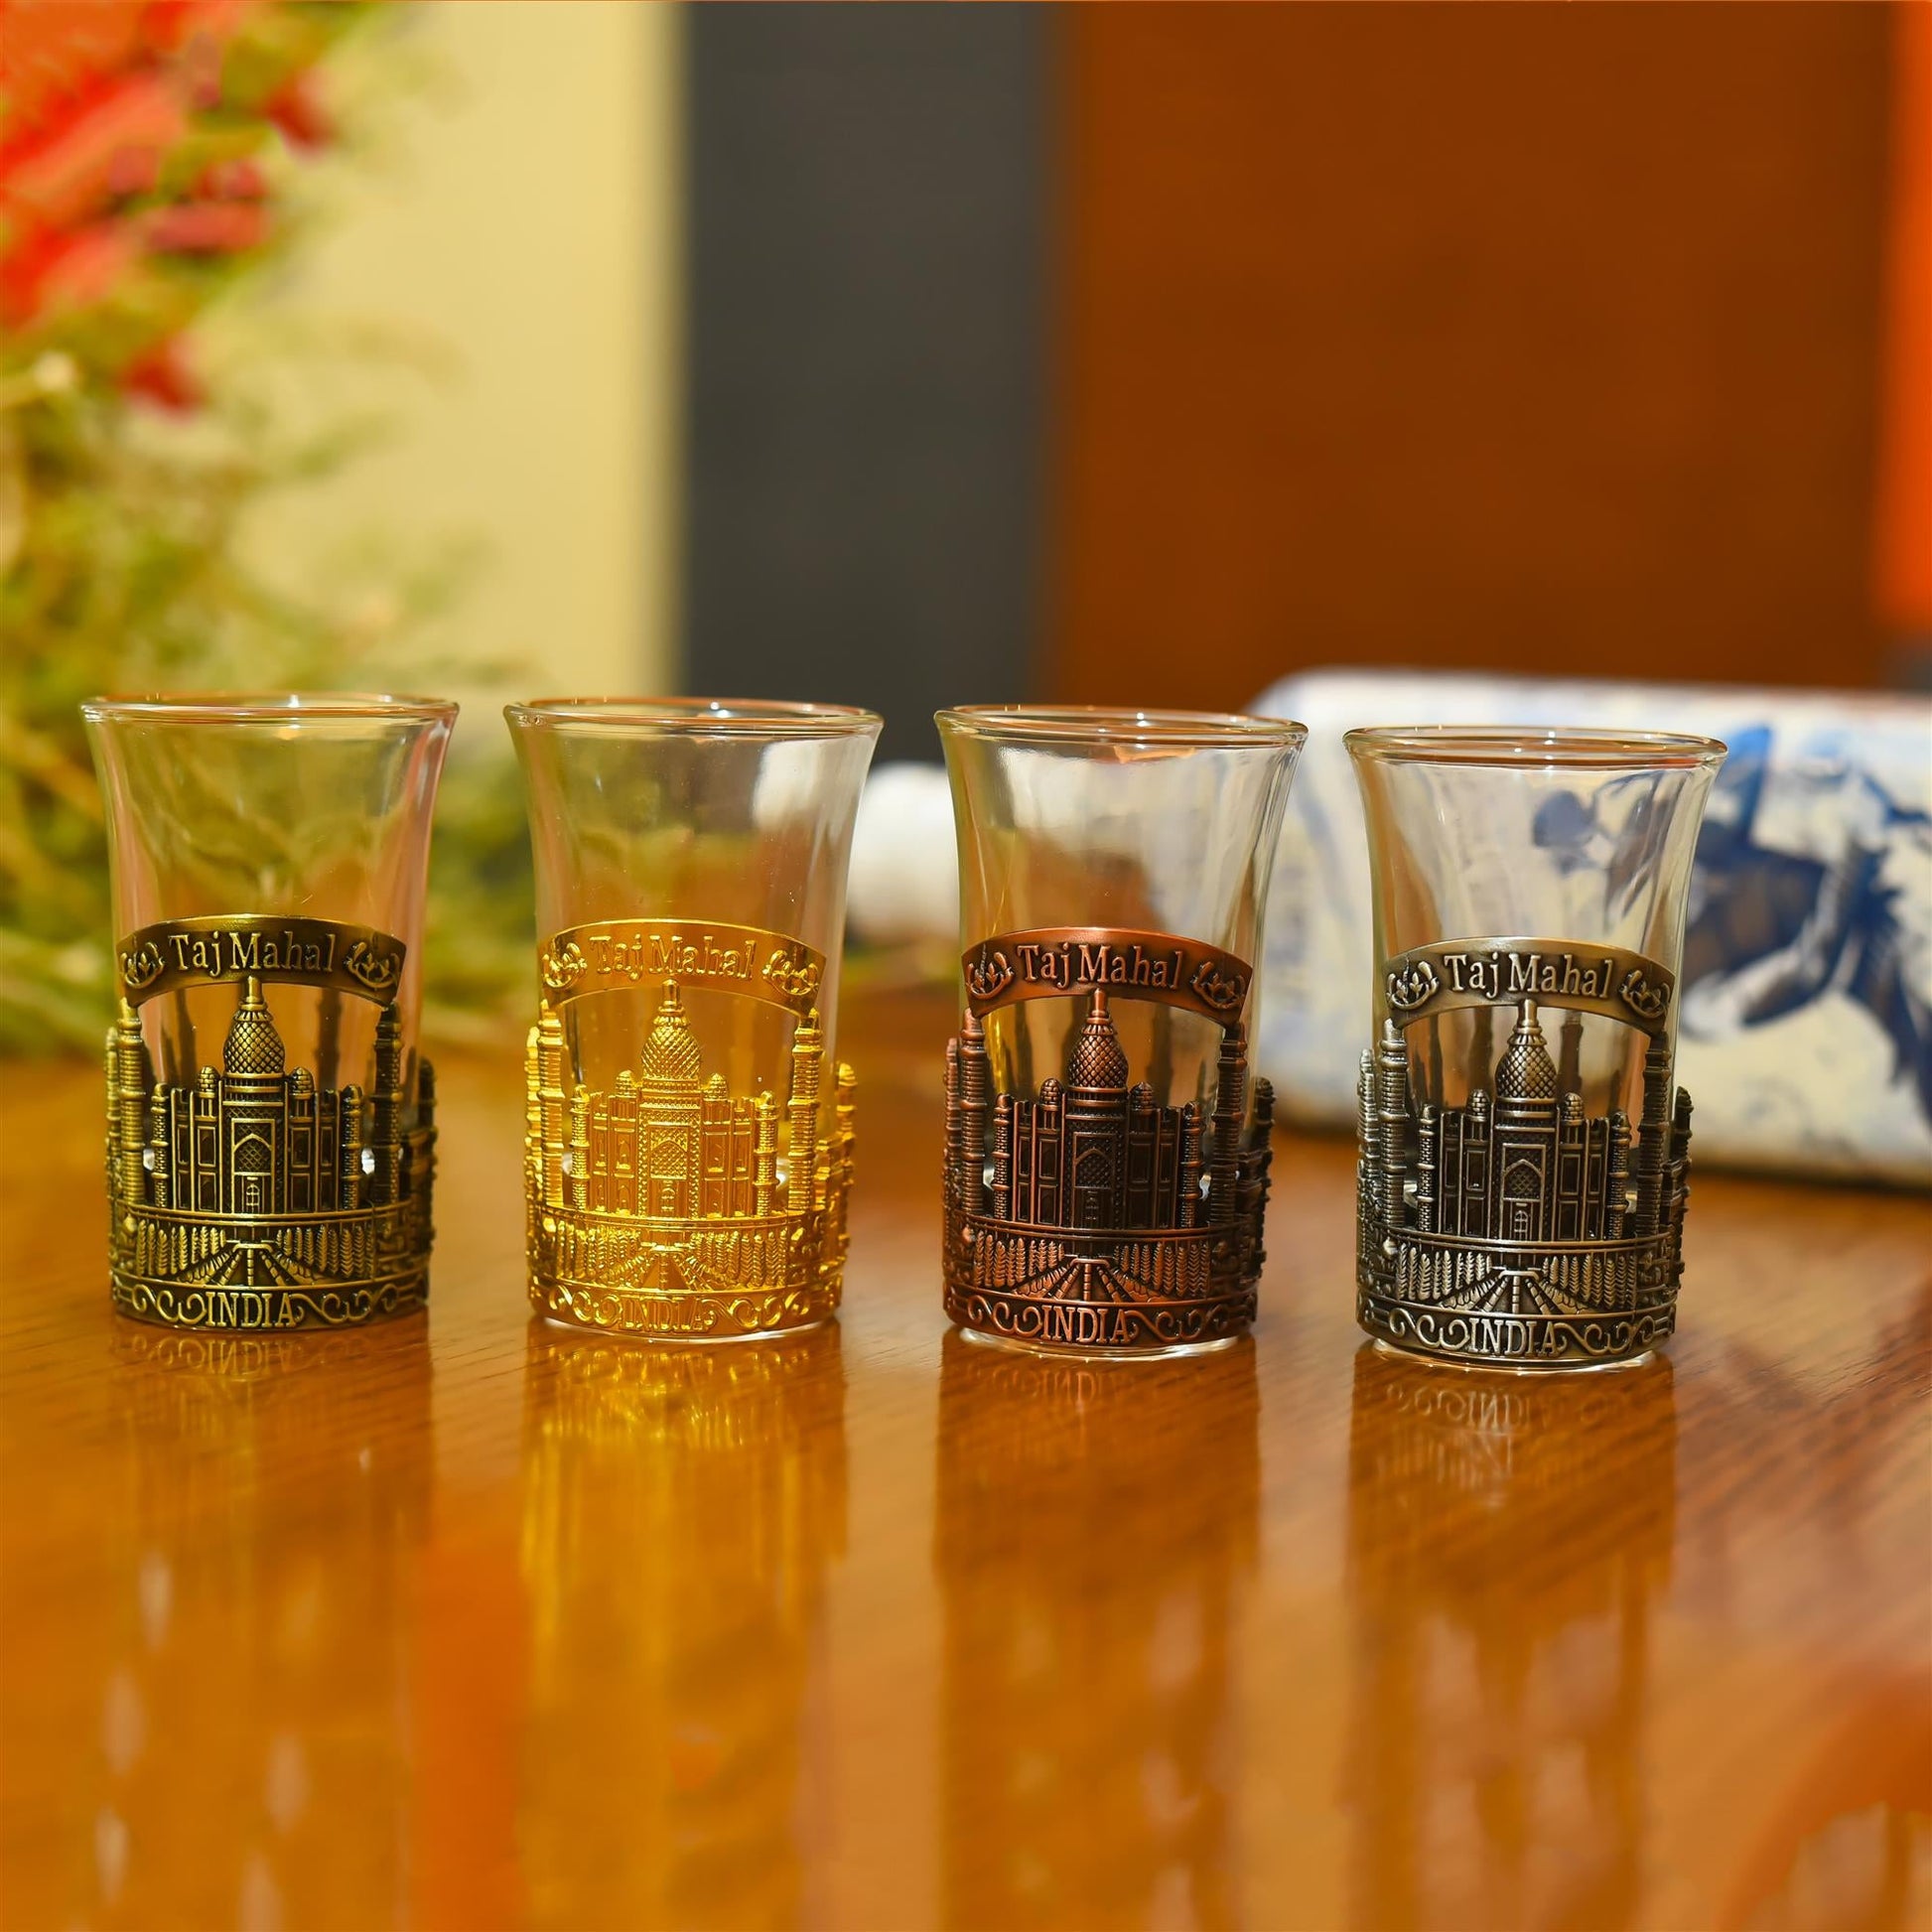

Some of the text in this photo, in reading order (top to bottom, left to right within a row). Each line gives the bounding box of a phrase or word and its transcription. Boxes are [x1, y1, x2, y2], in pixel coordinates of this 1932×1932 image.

[169, 930, 337, 977] Taj Mahal
[590, 933, 757, 980] Taj Mahal
[1017, 942, 1182, 989] Taj Mahal
[1444, 951, 1612, 999] Taj Mahal
[206, 1292, 297, 1327] INDIA
[621, 1295, 704, 1332] INDIA
[1040, 1305, 1130, 1344] INDIA
[1467, 1317, 1559, 1356] INDIA
